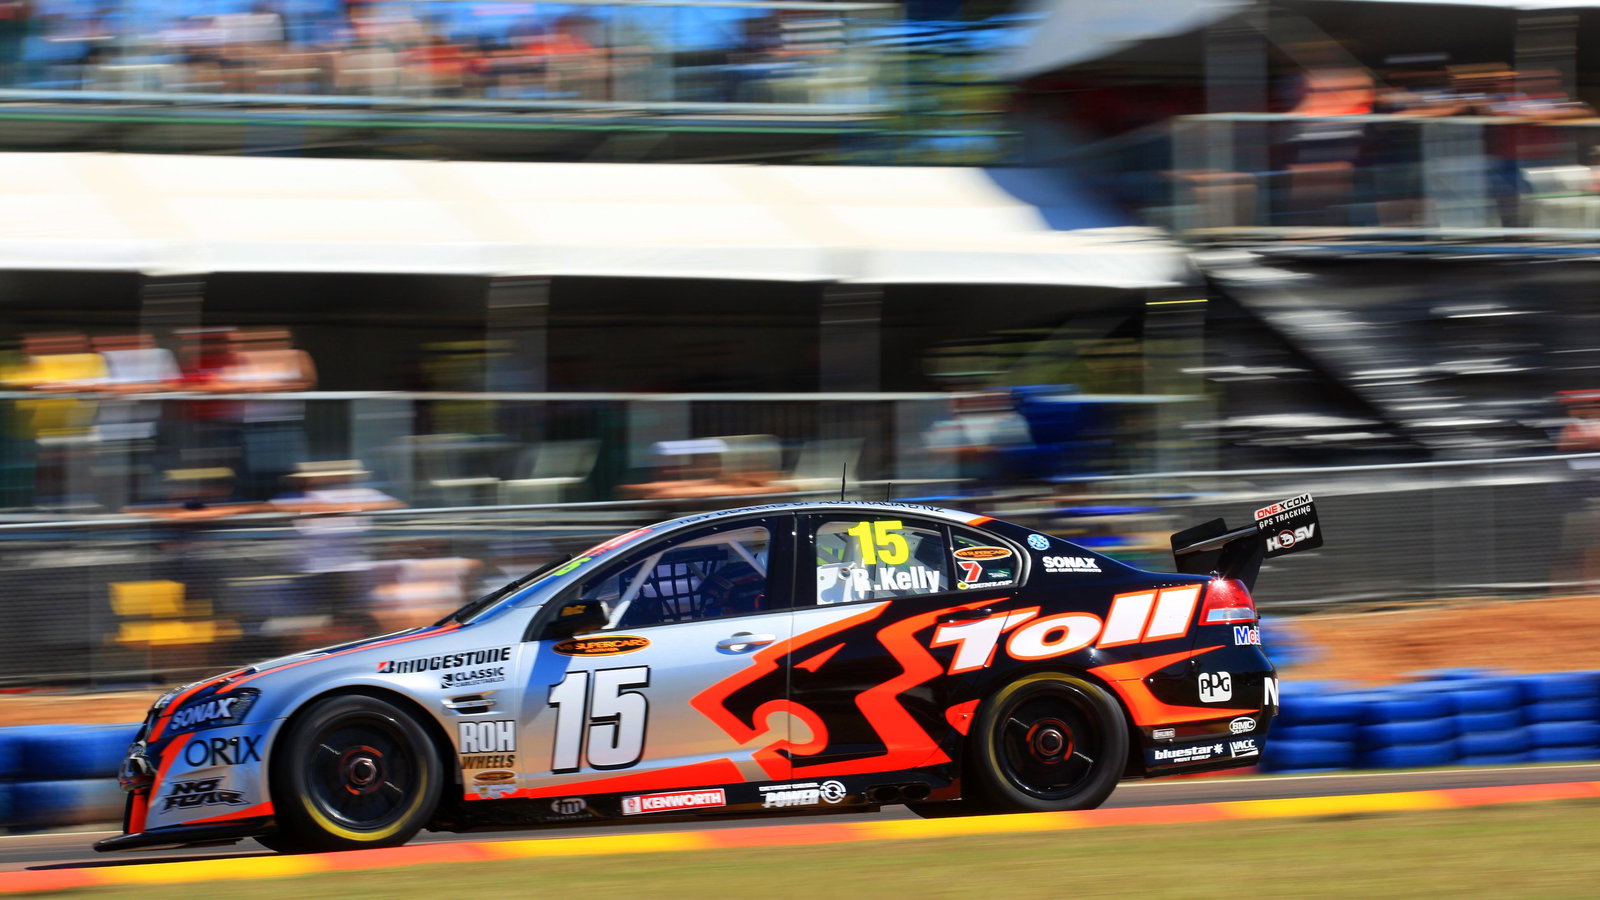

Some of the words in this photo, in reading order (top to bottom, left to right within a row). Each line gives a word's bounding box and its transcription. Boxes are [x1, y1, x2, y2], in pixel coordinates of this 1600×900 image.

[1259, 517, 1274, 529] GPS
[1275, 505, 1311, 523] TRACKING
[847, 520, 910, 565] 15
[1042, 555, 1099, 569] SONAX
[851, 565, 940, 593] R.Kelly
[929, 584, 1203, 675] Toll
[575, 638, 648, 650] SUPERCARS
[377, 647, 511, 673] BRIDGESTONE
[455, 666, 504, 682] CLASSIC
[1201, 673, 1230, 697] PPG
[170, 697, 238, 730] SONAX
[547, 665, 650, 775] 15
[1232, 720, 1254, 730] BMC
[458, 720, 516, 754] ROH
[1232, 739, 1256, 749] VACC
[185, 734, 262, 767] ORIX
[462, 754, 515, 770] WHEELS
[1154, 744, 1214, 760] bluestar
[642, 790, 722, 809] KENWORTH
[761, 788, 819, 808] POWER
